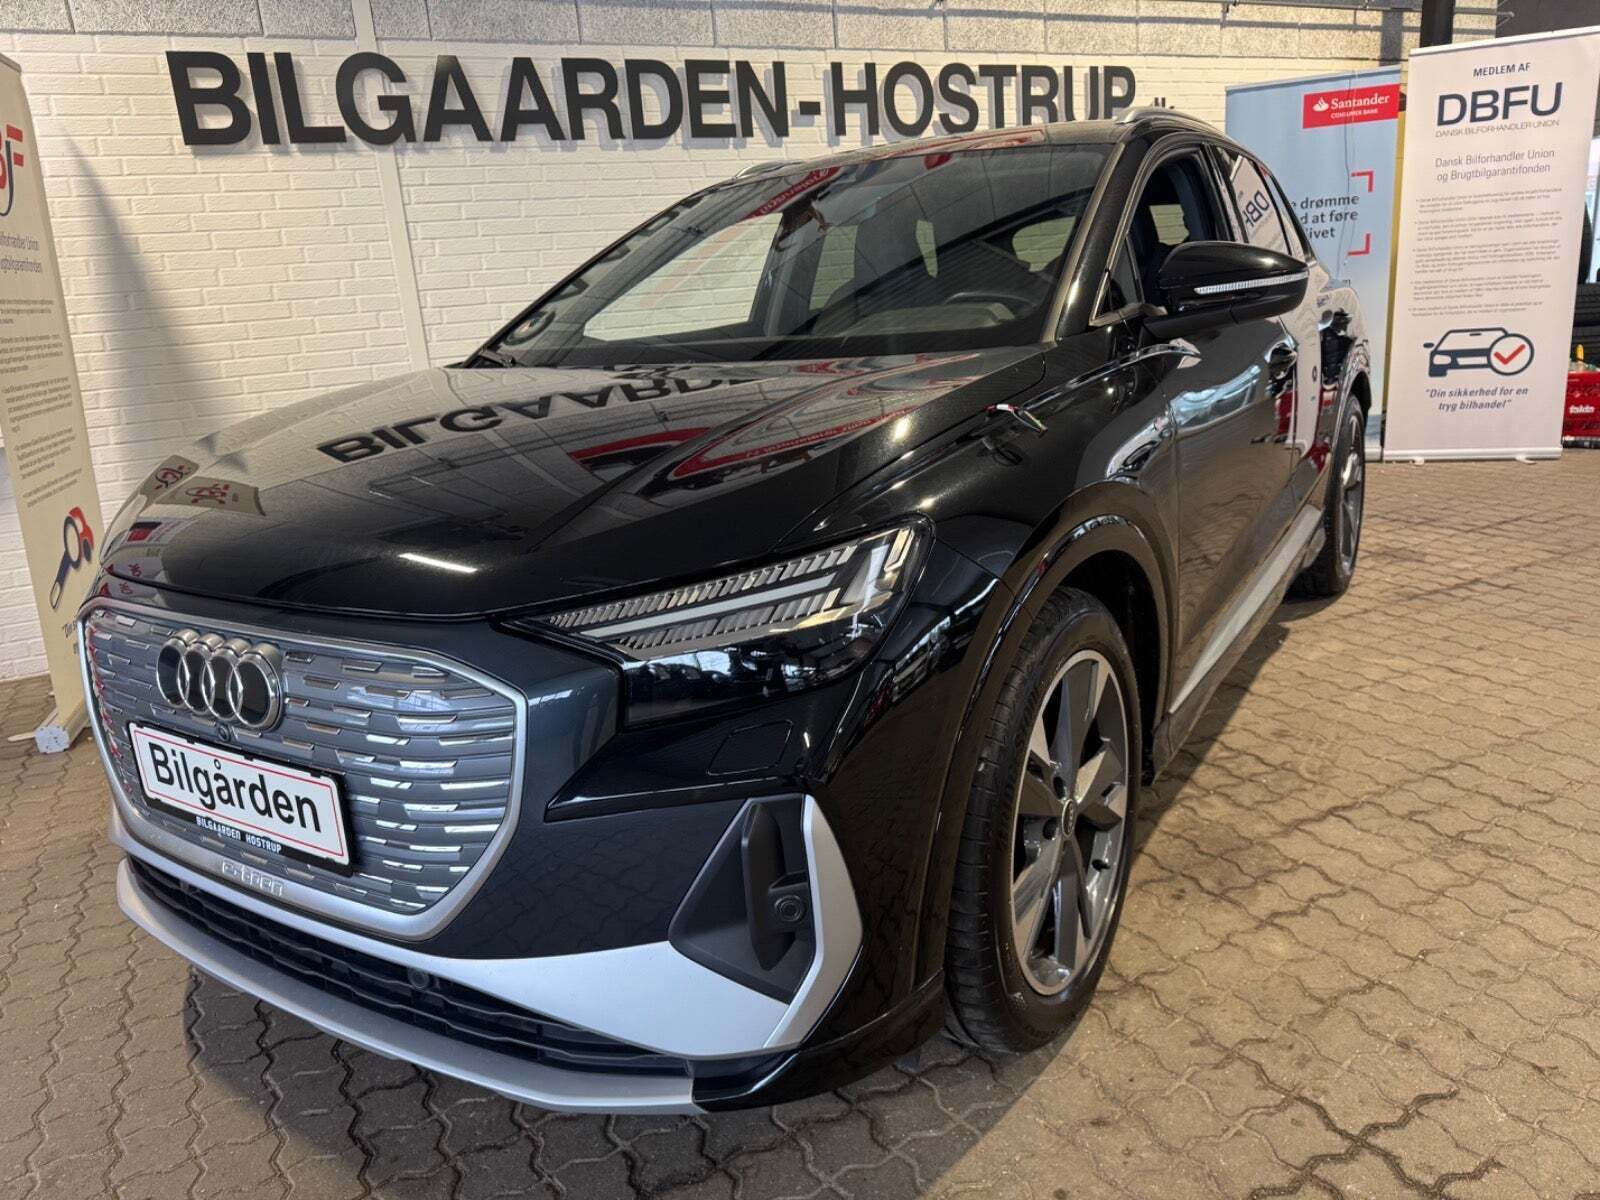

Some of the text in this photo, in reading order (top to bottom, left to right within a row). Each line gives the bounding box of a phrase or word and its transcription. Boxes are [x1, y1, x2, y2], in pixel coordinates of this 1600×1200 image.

[1473, 62, 1531, 77] MEDLEM AF
[166, 49, 1136, 146] BILGAARDEN-HOSTRUP
[1331, 92, 1390, 109] Santander
[1437, 82, 1563, 127] DBFU
[1435, 119, 1561, 138] DANSK BILFORHANDLER UNION
[1435, 149, 1555, 168] Dansk Bilforhandler Union
[1437, 163, 1551, 182] og Brugtbilgarantifonden
[1300, 195, 1360, 210] drømme
[1312, 211, 1325, 224] at
[1329, 209, 1359, 222] føre
[1306, 227, 1336, 239] ivet
[1448, 387, 1498, 397] sikkerhed
[1499, 386, 1513, 396] for
[1515, 387, 1529, 395] en
[1438, 401, 1457, 412] tryg
[147, 742, 322, 833] Bilgården
[196, 815, 282, 853] BILGAARDEN HOSTRUP
